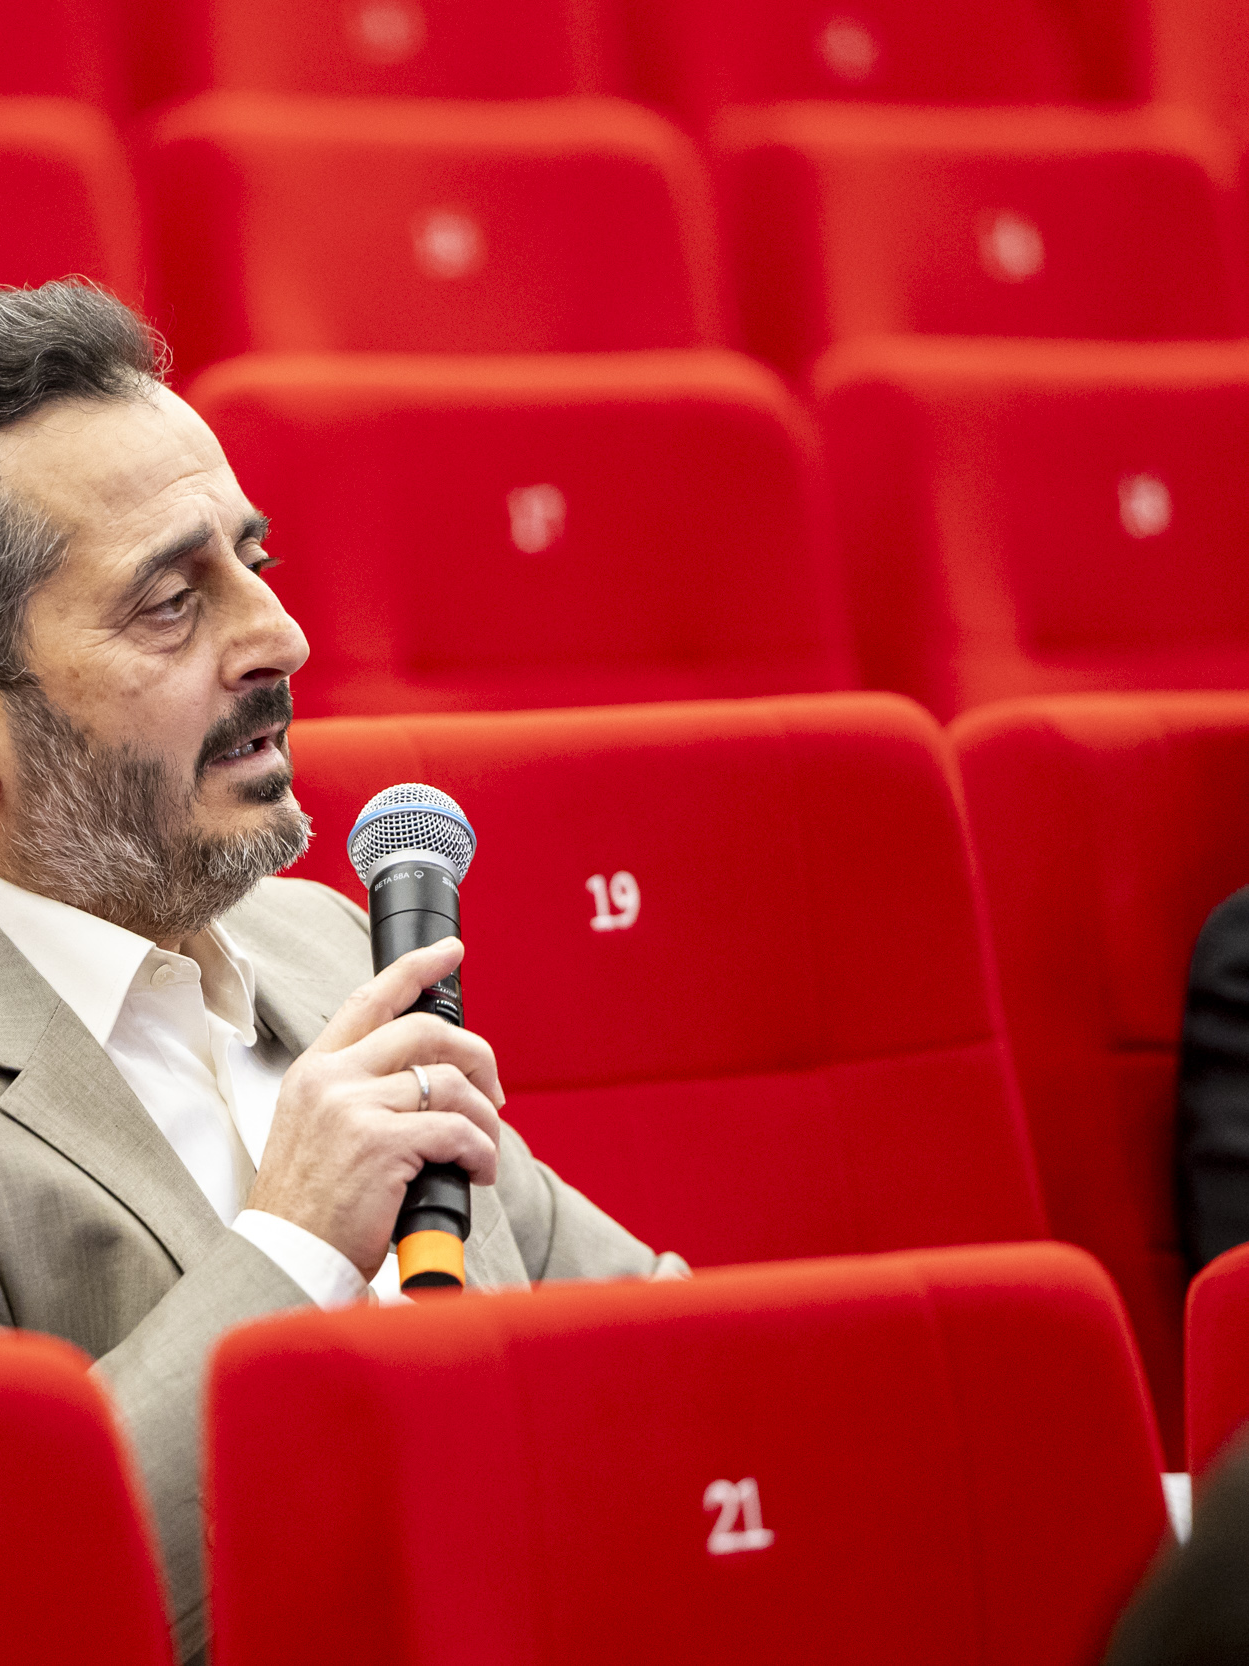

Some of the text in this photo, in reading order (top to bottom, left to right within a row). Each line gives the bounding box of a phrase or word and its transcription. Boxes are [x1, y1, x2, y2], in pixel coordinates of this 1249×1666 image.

[374, 871, 410, 892] BETA 58A
[585, 870, 641, 932] 19
[703, 1477, 775, 1556] 21
